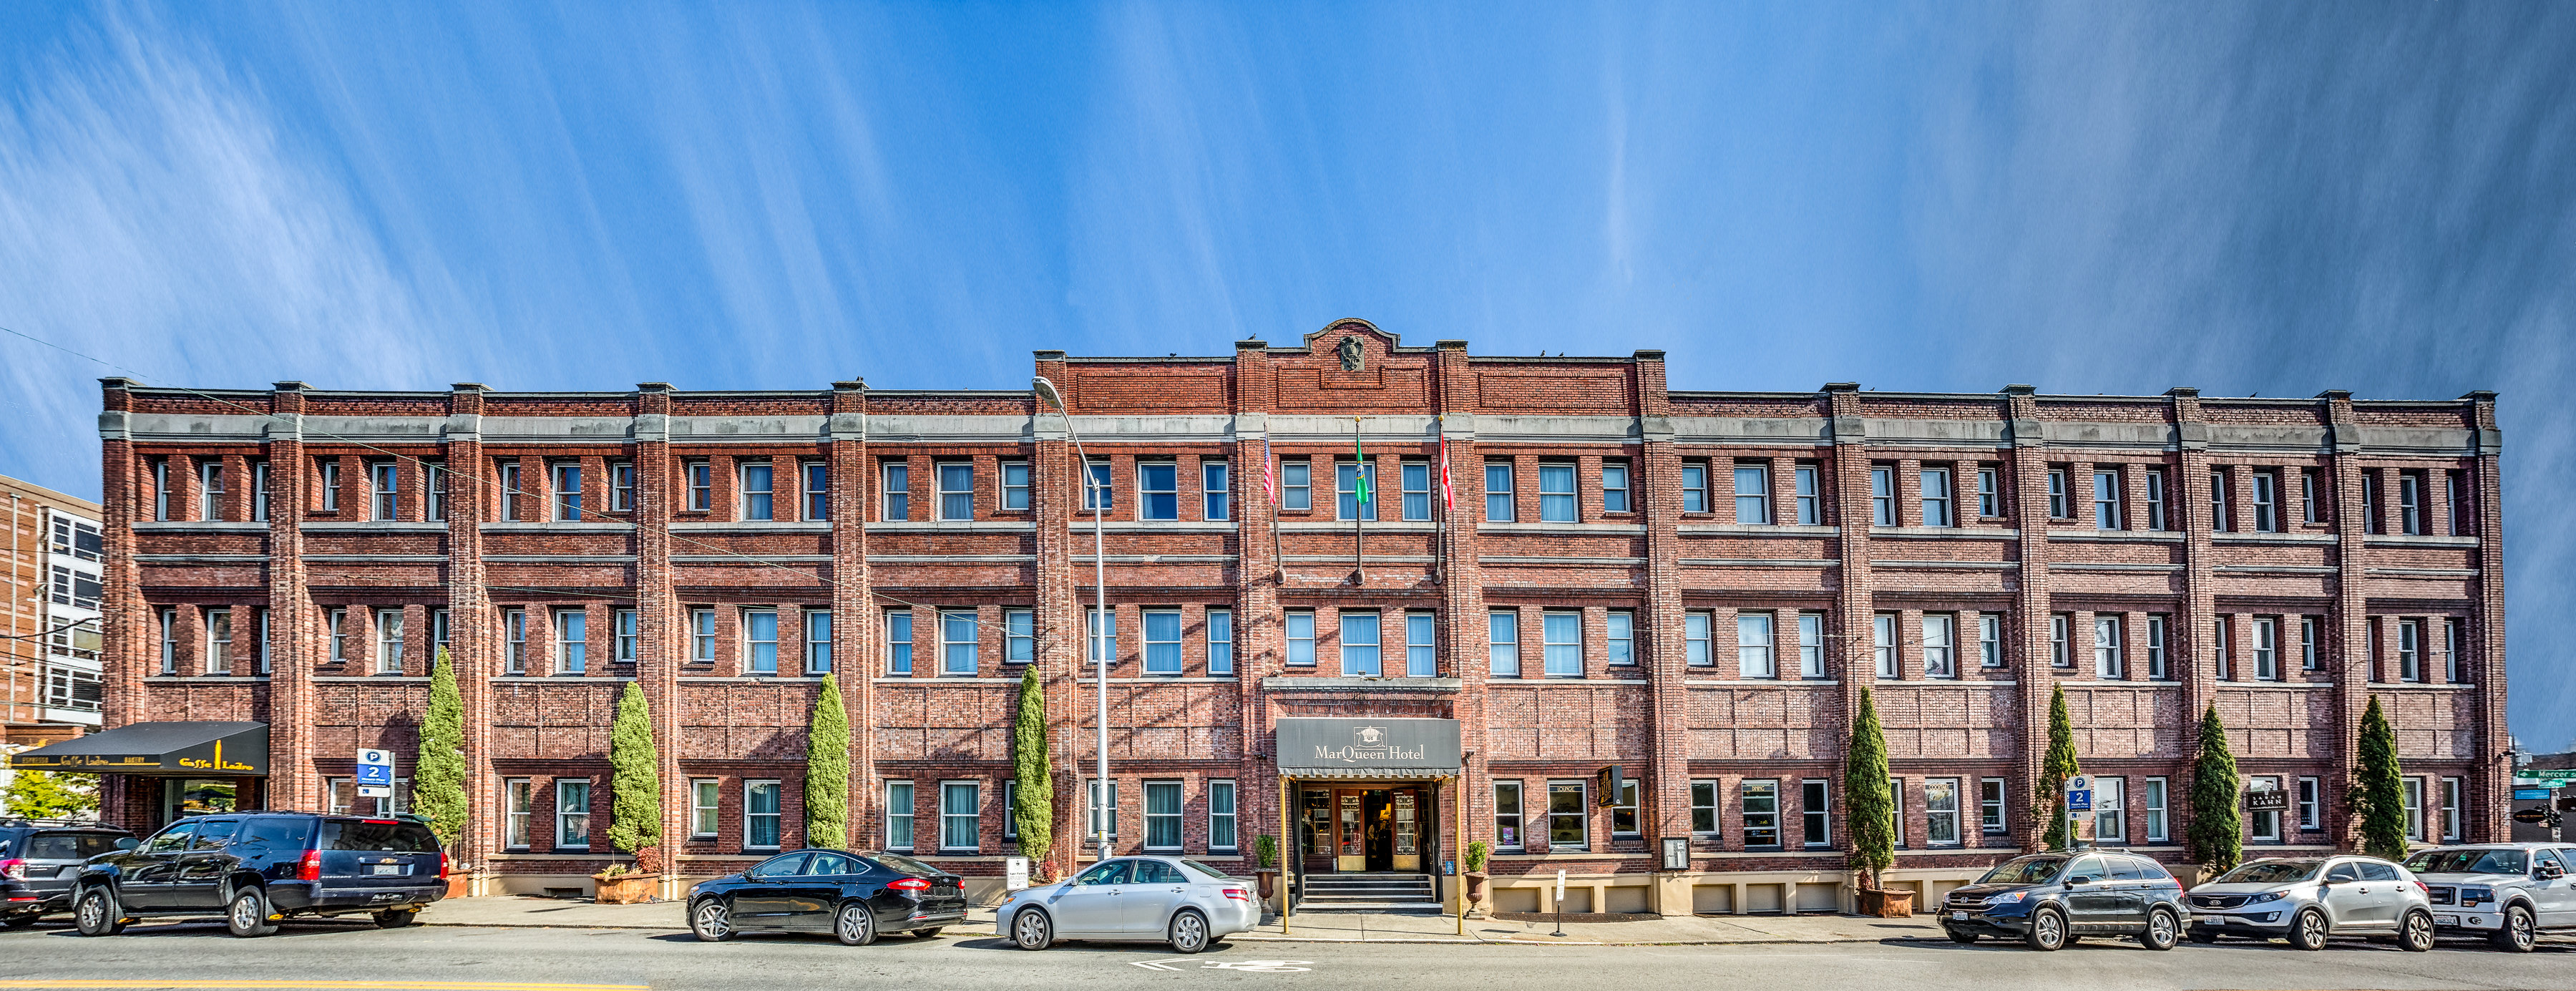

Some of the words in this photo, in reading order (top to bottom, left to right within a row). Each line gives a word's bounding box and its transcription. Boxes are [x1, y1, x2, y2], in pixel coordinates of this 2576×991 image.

[1314, 745, 1385, 763] MarQueen
[1388, 744, 1425, 760] Hotel
[222, 761, 254, 771] Ladro
[368, 766, 379, 778] 2
[2076, 792, 2084, 802] 2
